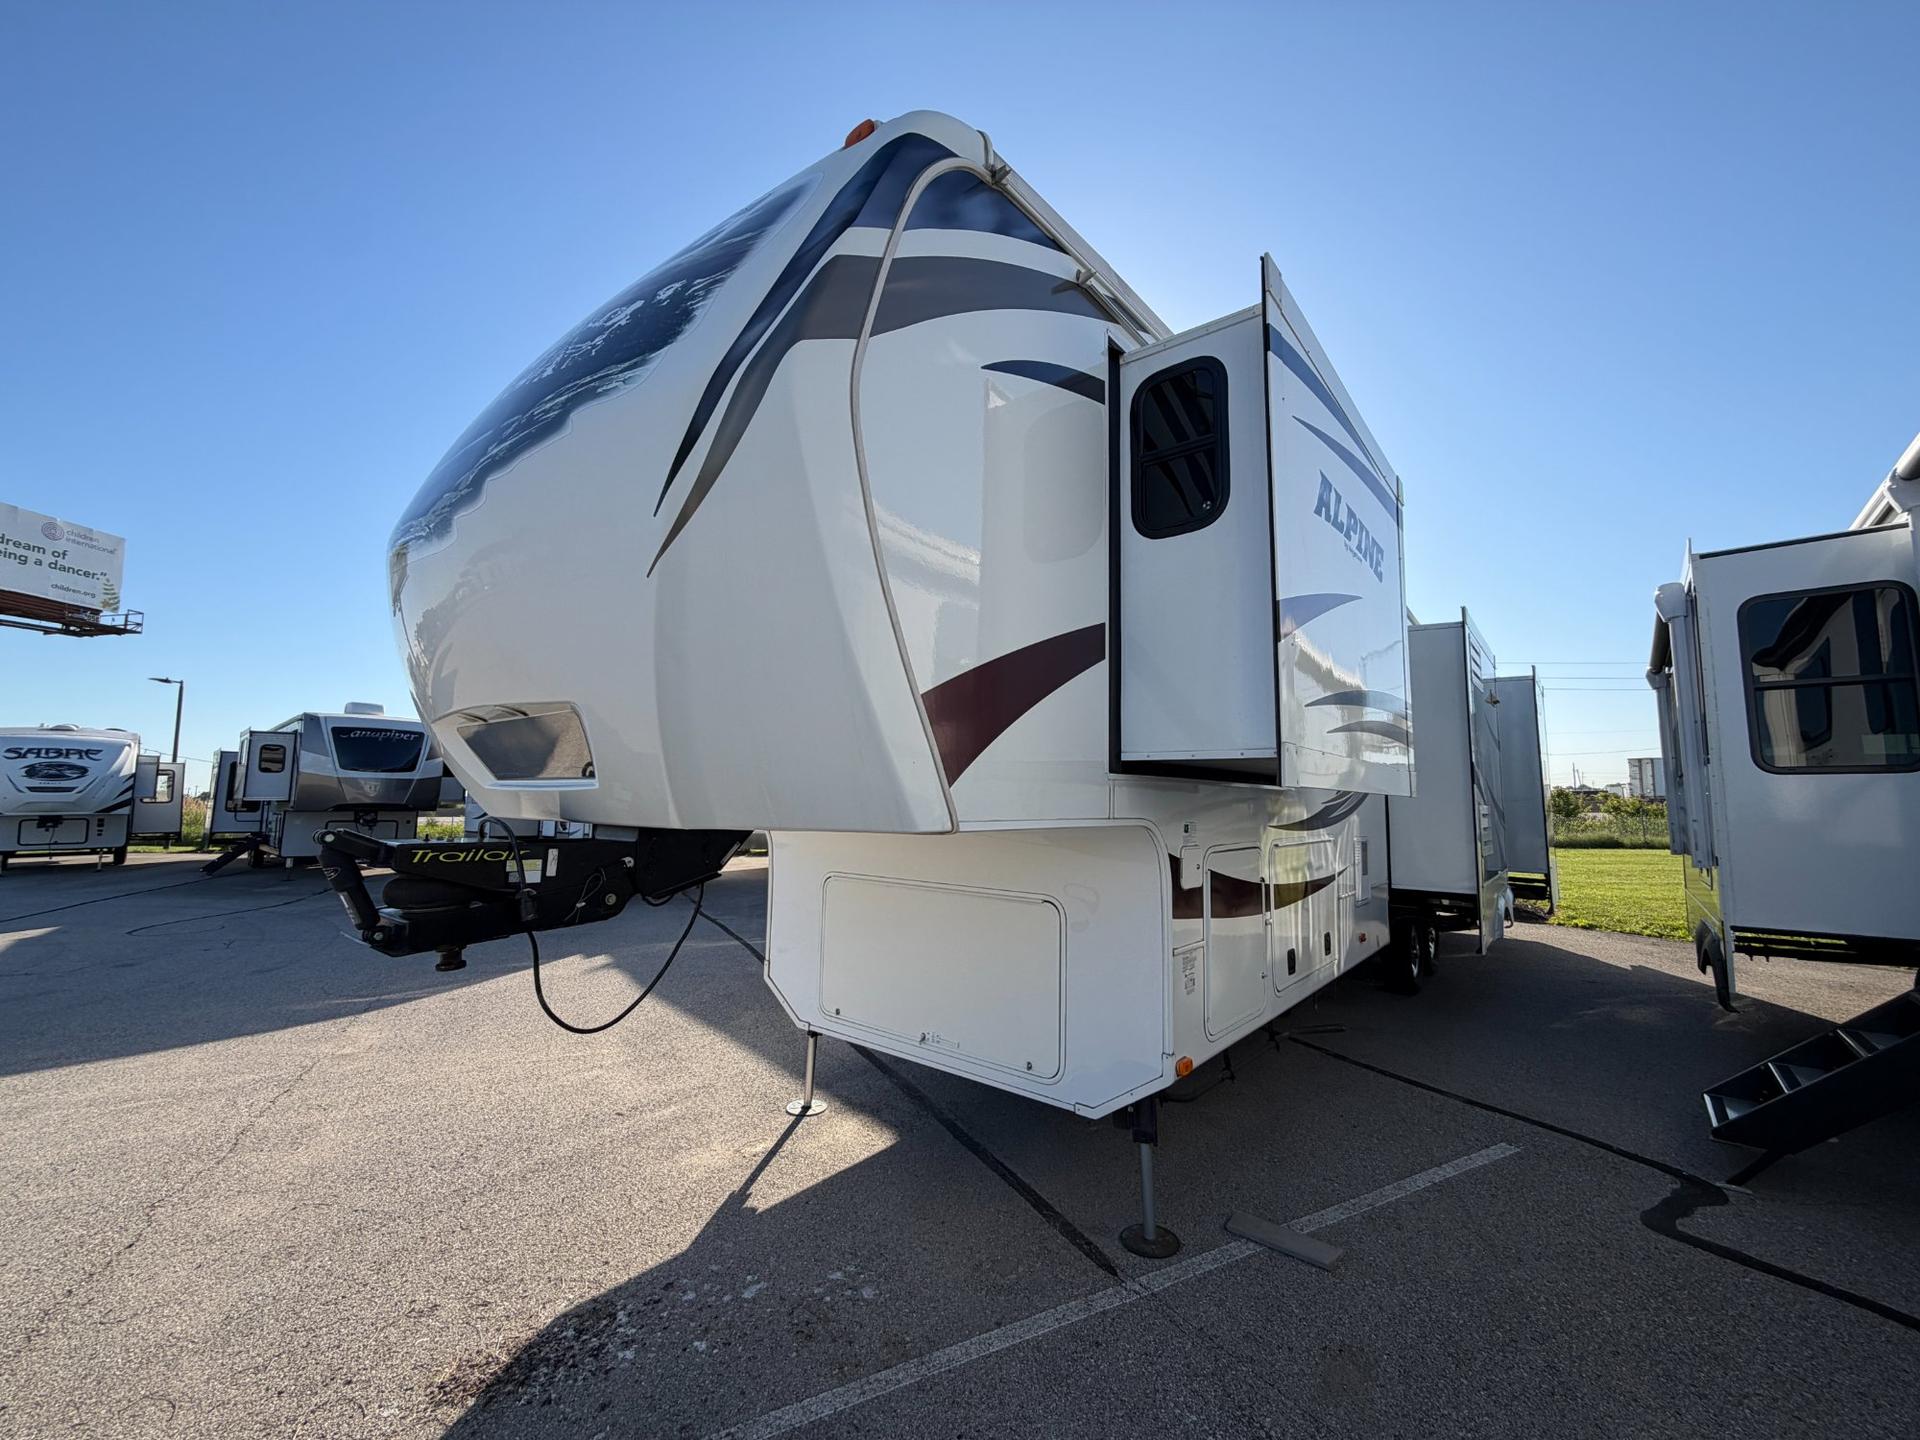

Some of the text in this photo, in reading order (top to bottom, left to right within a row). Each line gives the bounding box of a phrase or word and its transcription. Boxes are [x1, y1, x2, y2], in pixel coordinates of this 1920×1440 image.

[1313, 469, 1384, 583] ALPINE
[66, 528, 100, 543] children
[65, 536, 116, 555] international
[33, 558, 43, 567] a
[51, 550, 69, 560] of
[50, 583, 97, 599] children.org
[3, 747, 104, 761] SABRE
